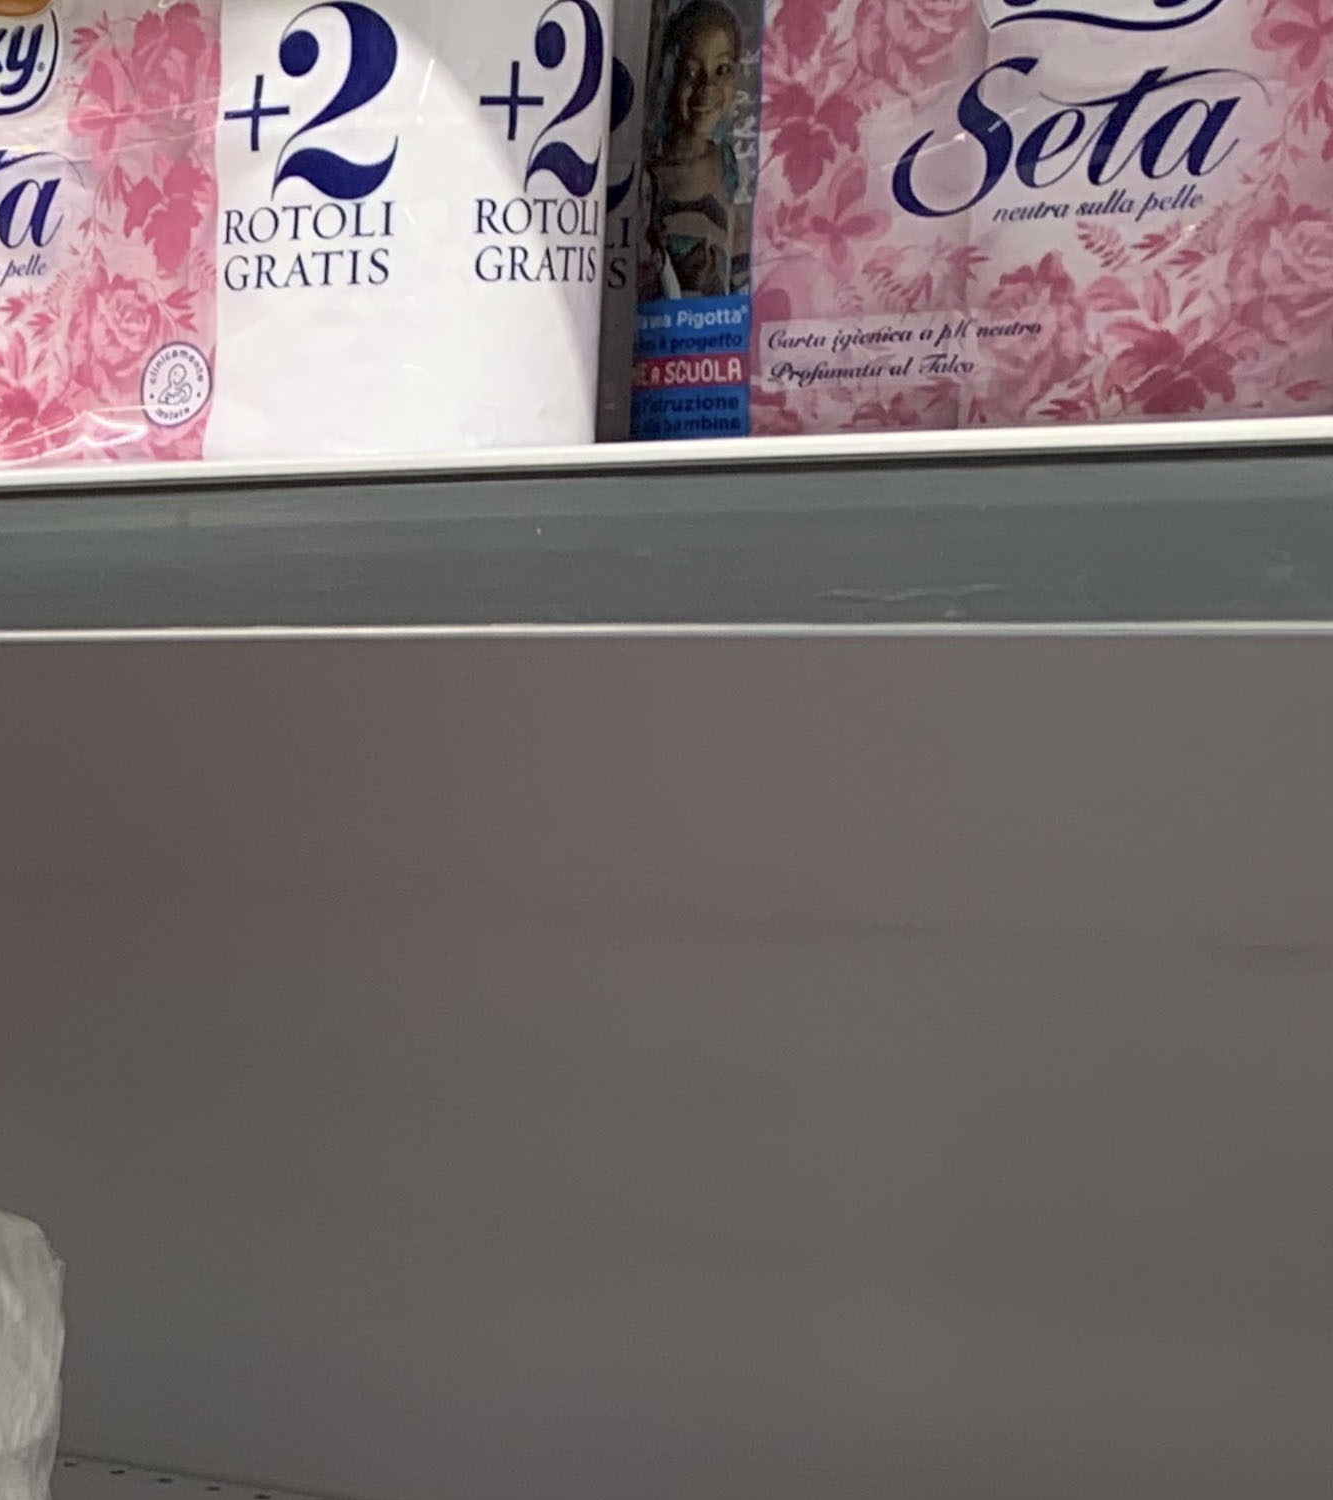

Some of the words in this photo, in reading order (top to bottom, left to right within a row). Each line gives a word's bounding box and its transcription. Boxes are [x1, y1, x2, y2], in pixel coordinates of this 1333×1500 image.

[223, 1, 399, 201] +2
[479, 0, 603, 198] +2
[893, 56, 1253, 218] Seta
[473, 197, 601, 238] ROTOLI
[993, 196, 1070, 222] neutra
[1075, 185, 1132, 218] sulla
[1134, 185, 1204, 222] pelle
[222, 201, 396, 246] ROTOLI
[0, 255, 48, 286] pelle
[224, 248, 390, 291] GRATIS
[474, 246, 597, 284] GRATIS
[671, 333, 743, 353] progetto
[769, 329, 826, 349] Carta
[832, 326, 912, 352] igienica
[919, 329, 933, 341] a
[976, 321, 1041, 338] neutro
[664, 358, 743, 384] SCUOLA
[769, 361, 883, 387] Profumata
[889, 357, 913, 375] al
